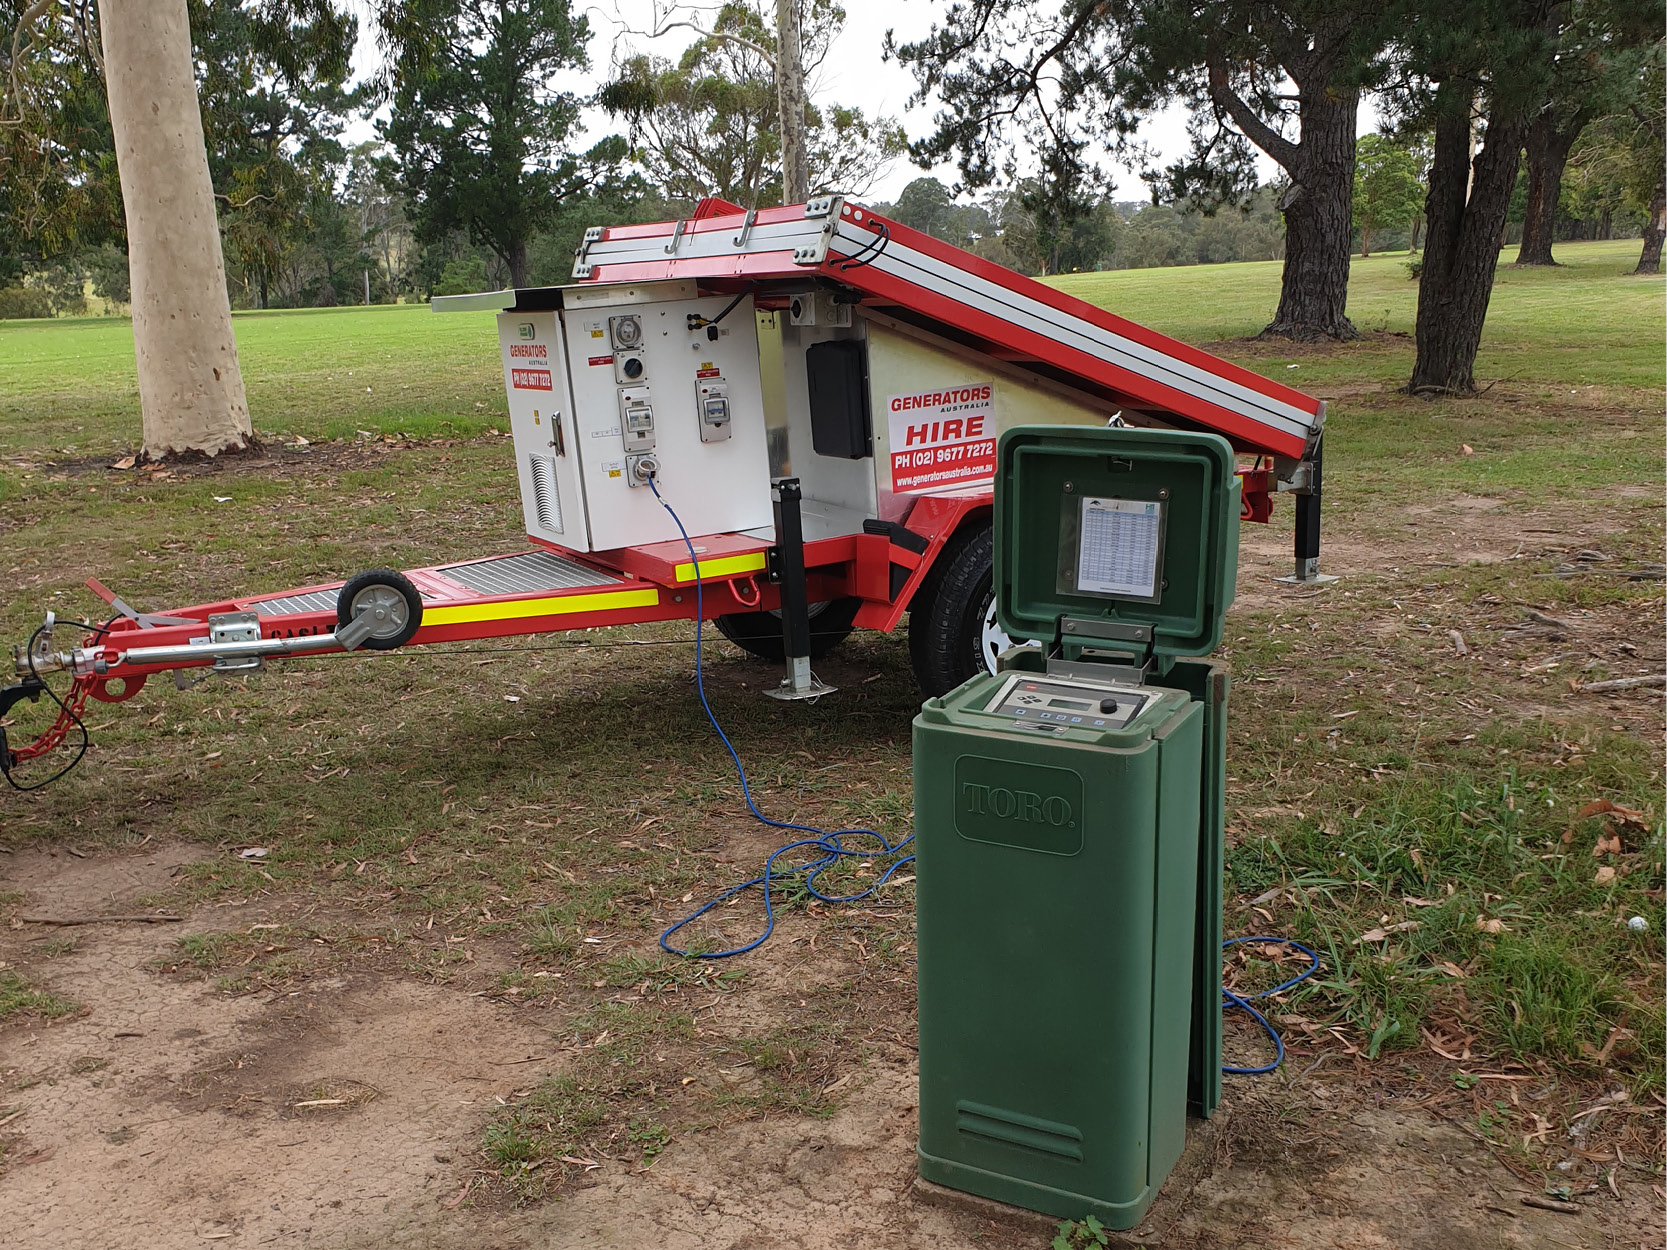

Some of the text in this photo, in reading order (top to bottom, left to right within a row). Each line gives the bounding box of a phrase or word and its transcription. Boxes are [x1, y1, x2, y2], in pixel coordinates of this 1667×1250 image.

[510, 344, 547, 358] GENERATORS
[891, 386, 991, 412] GENERATORS
[940, 402, 989, 413] AUSTRALIA
[905, 416, 984, 446] HIRE
[895, 442, 993, 469] PH (02) 9677 7272
[896, 464, 992, 486] www.generatorsaustralia.com.au
